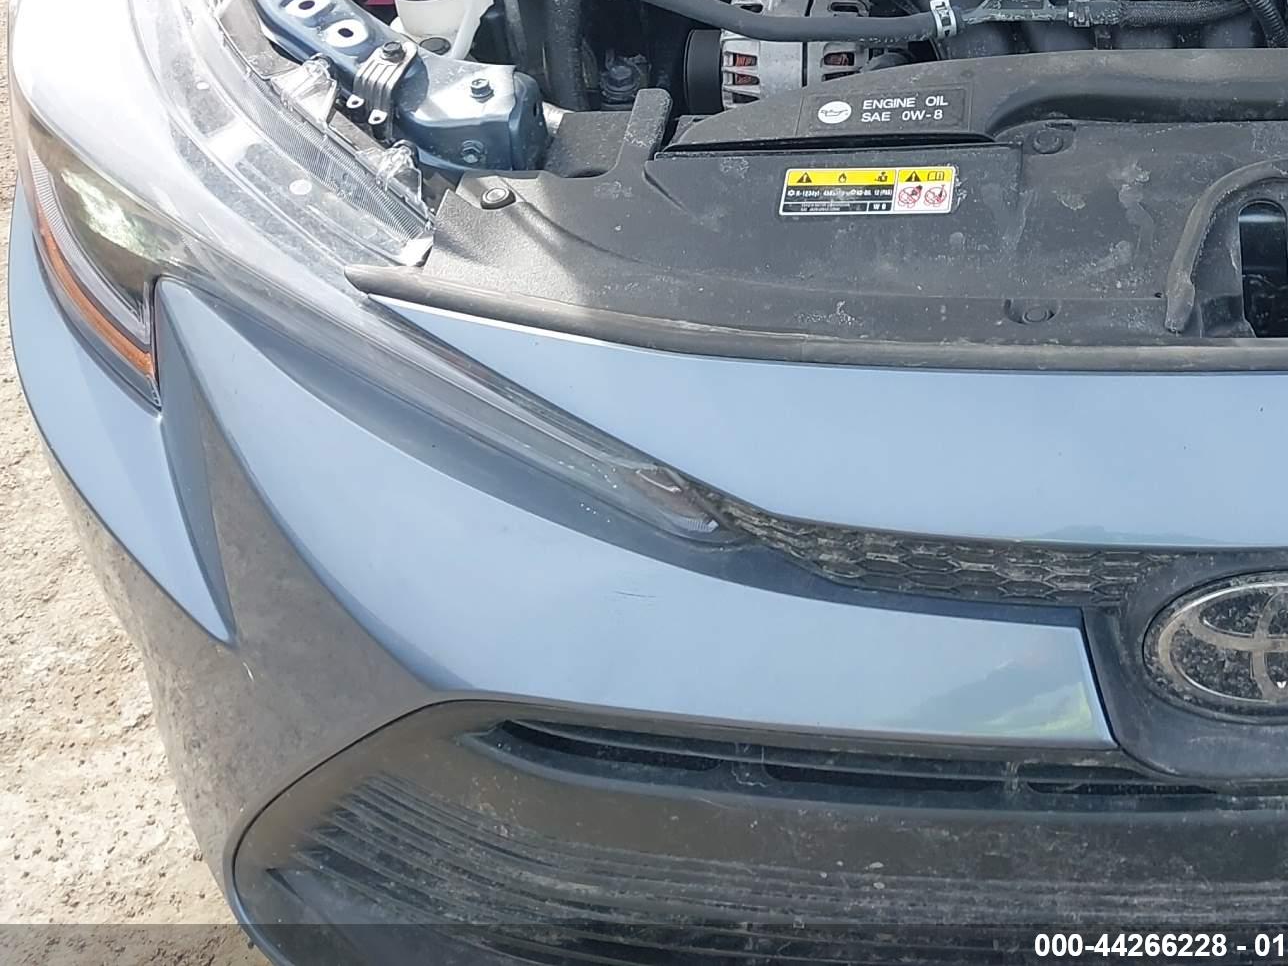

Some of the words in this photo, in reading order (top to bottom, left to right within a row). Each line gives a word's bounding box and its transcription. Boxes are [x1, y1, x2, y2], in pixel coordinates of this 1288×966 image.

[863, 97, 916, 110] ENGINE
[925, 95, 948, 107] OIL
[861, 111, 891, 122] SAE
[901, 109, 943, 121] 0W-8
